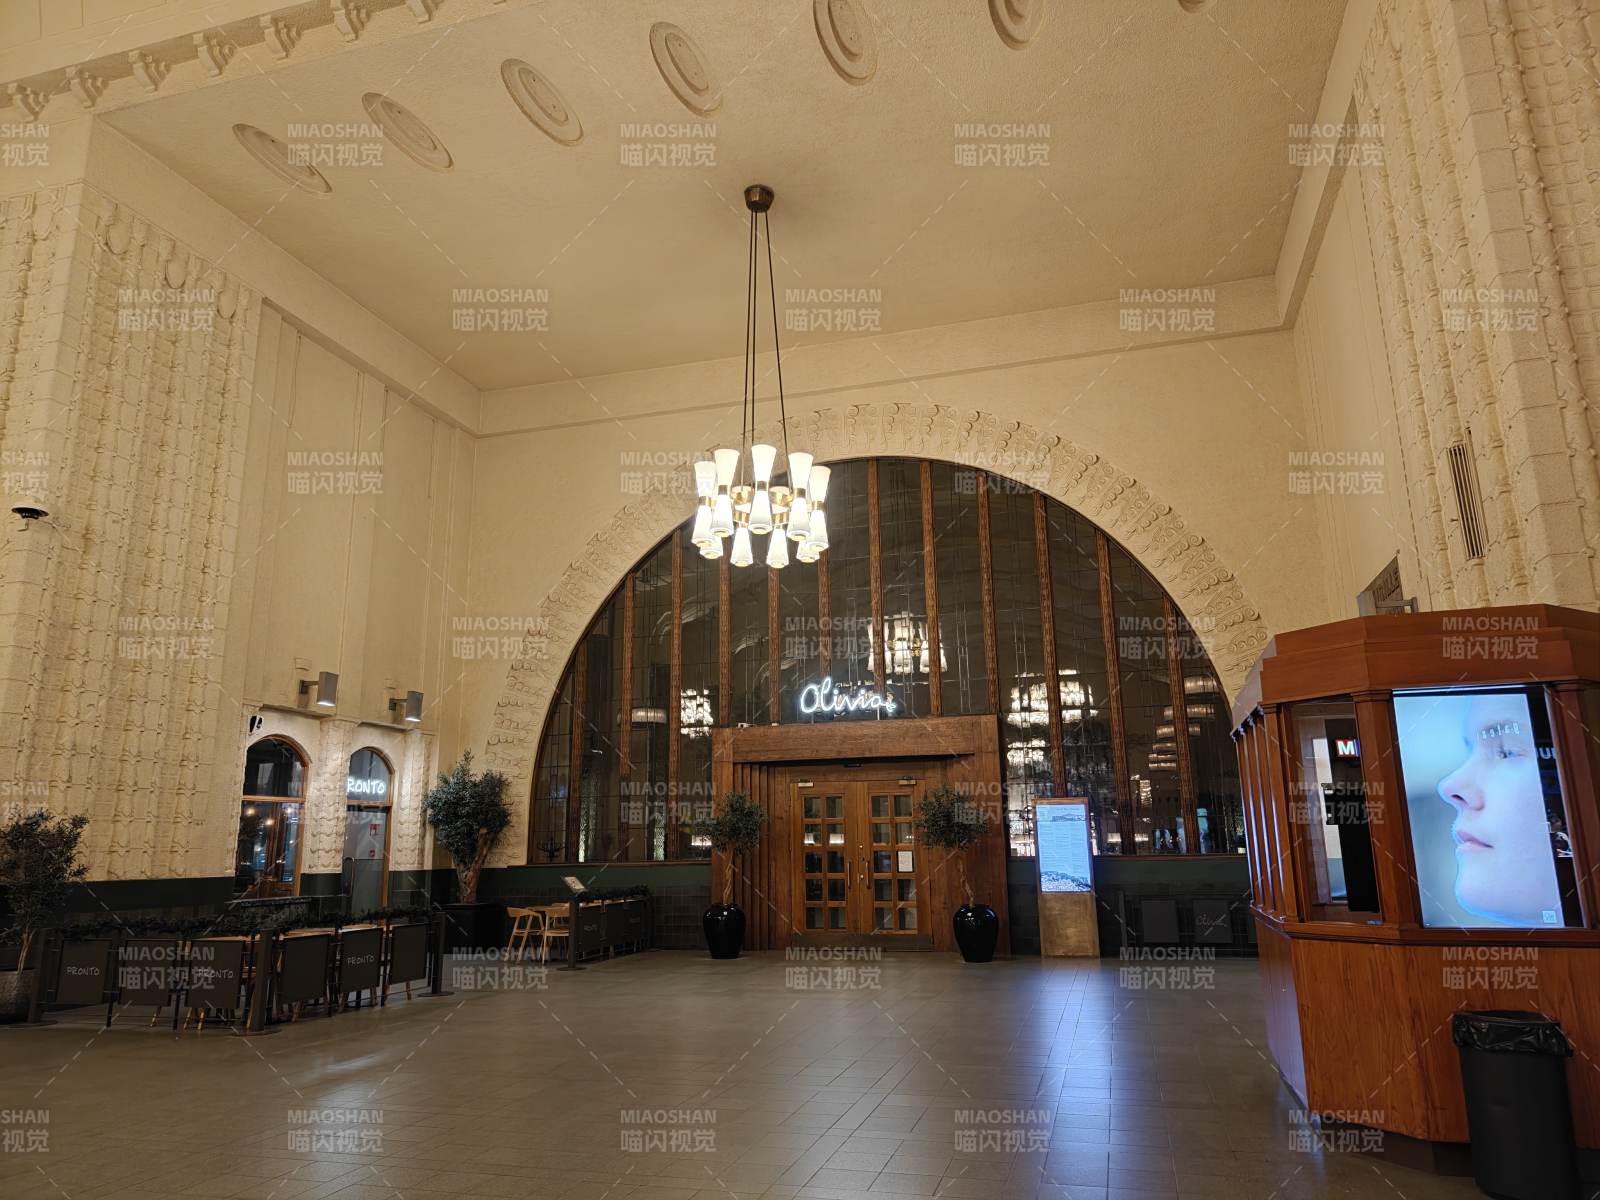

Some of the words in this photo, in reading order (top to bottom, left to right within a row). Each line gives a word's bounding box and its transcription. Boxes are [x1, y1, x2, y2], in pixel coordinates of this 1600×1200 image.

[800, 676, 888, 713] Olivia
[347, 954, 375, 966] PRONTO
[66, 966, 100, 977] PRONTO
